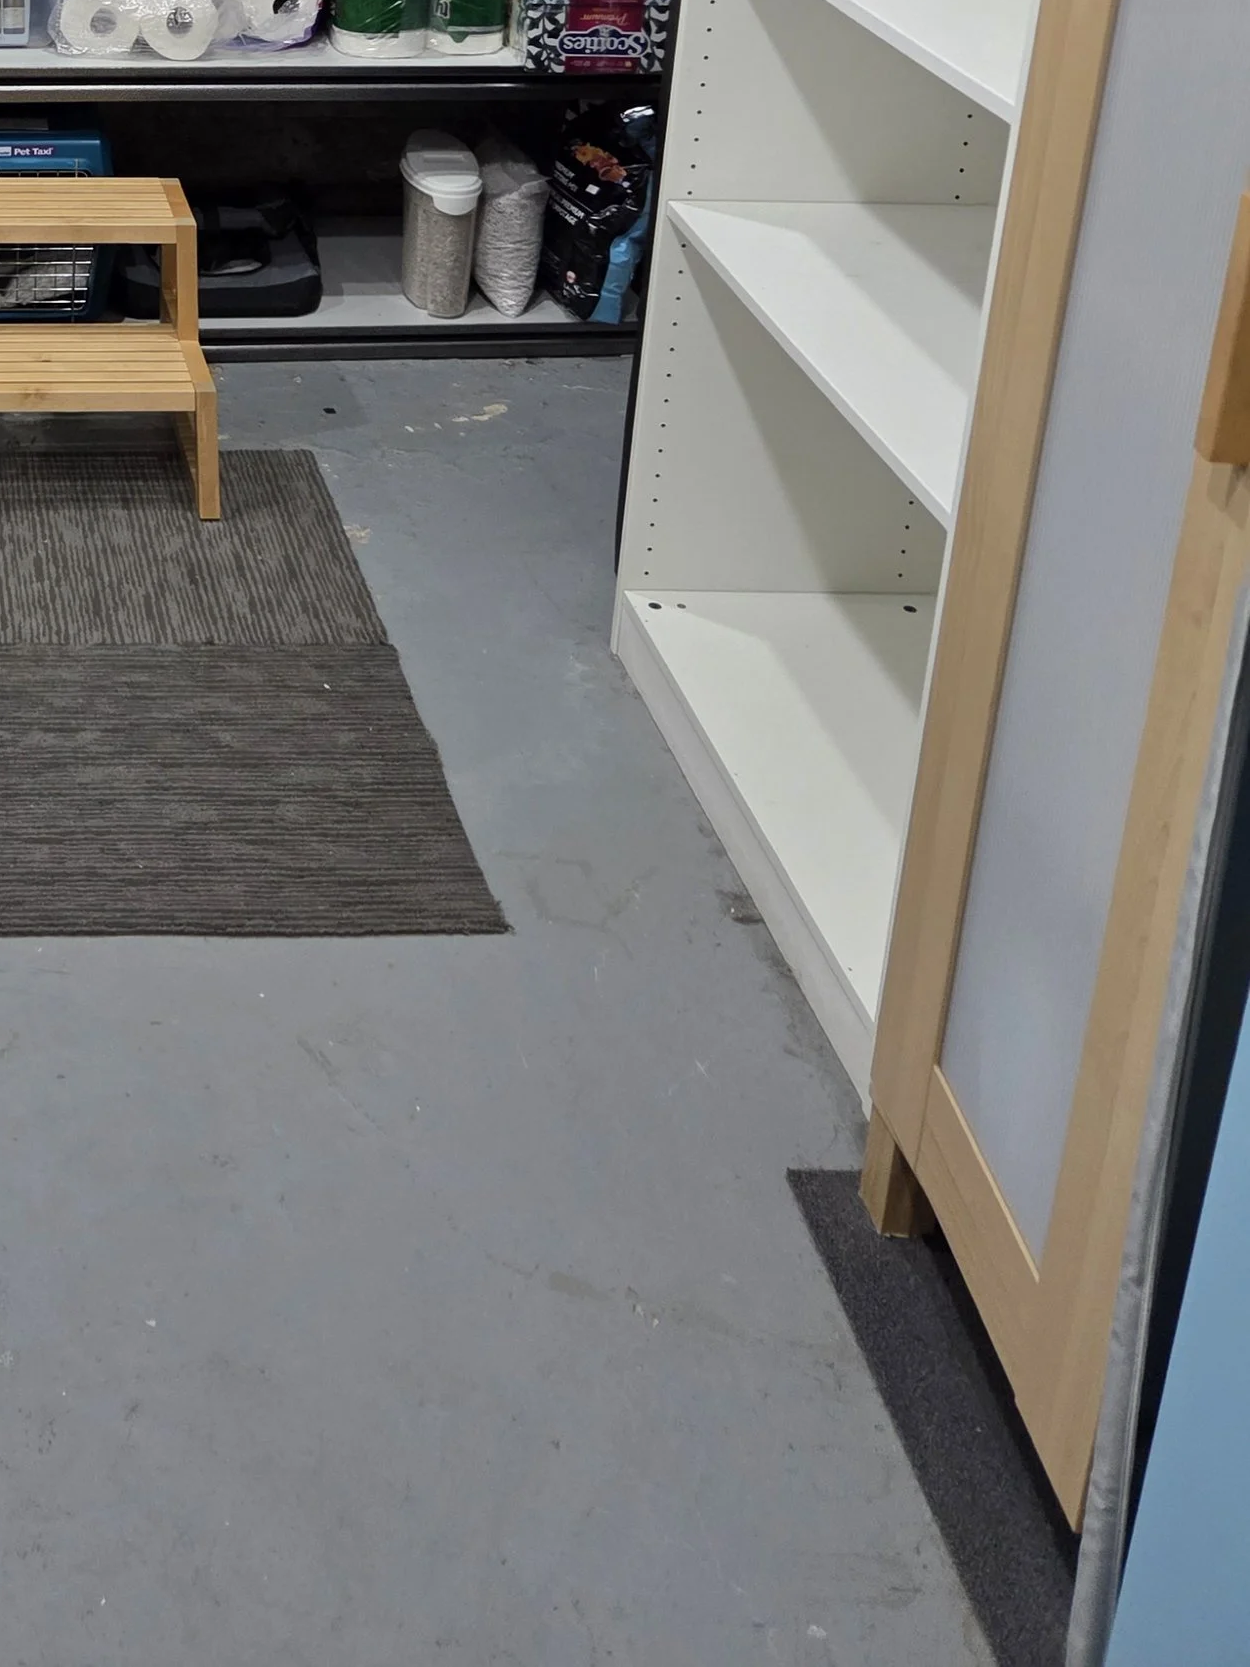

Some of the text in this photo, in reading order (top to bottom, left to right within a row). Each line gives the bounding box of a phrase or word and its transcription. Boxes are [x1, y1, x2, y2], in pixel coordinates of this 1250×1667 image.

[562, 35, 646, 56] Scotties
[14, 147, 52, 156] Pet Taxi
